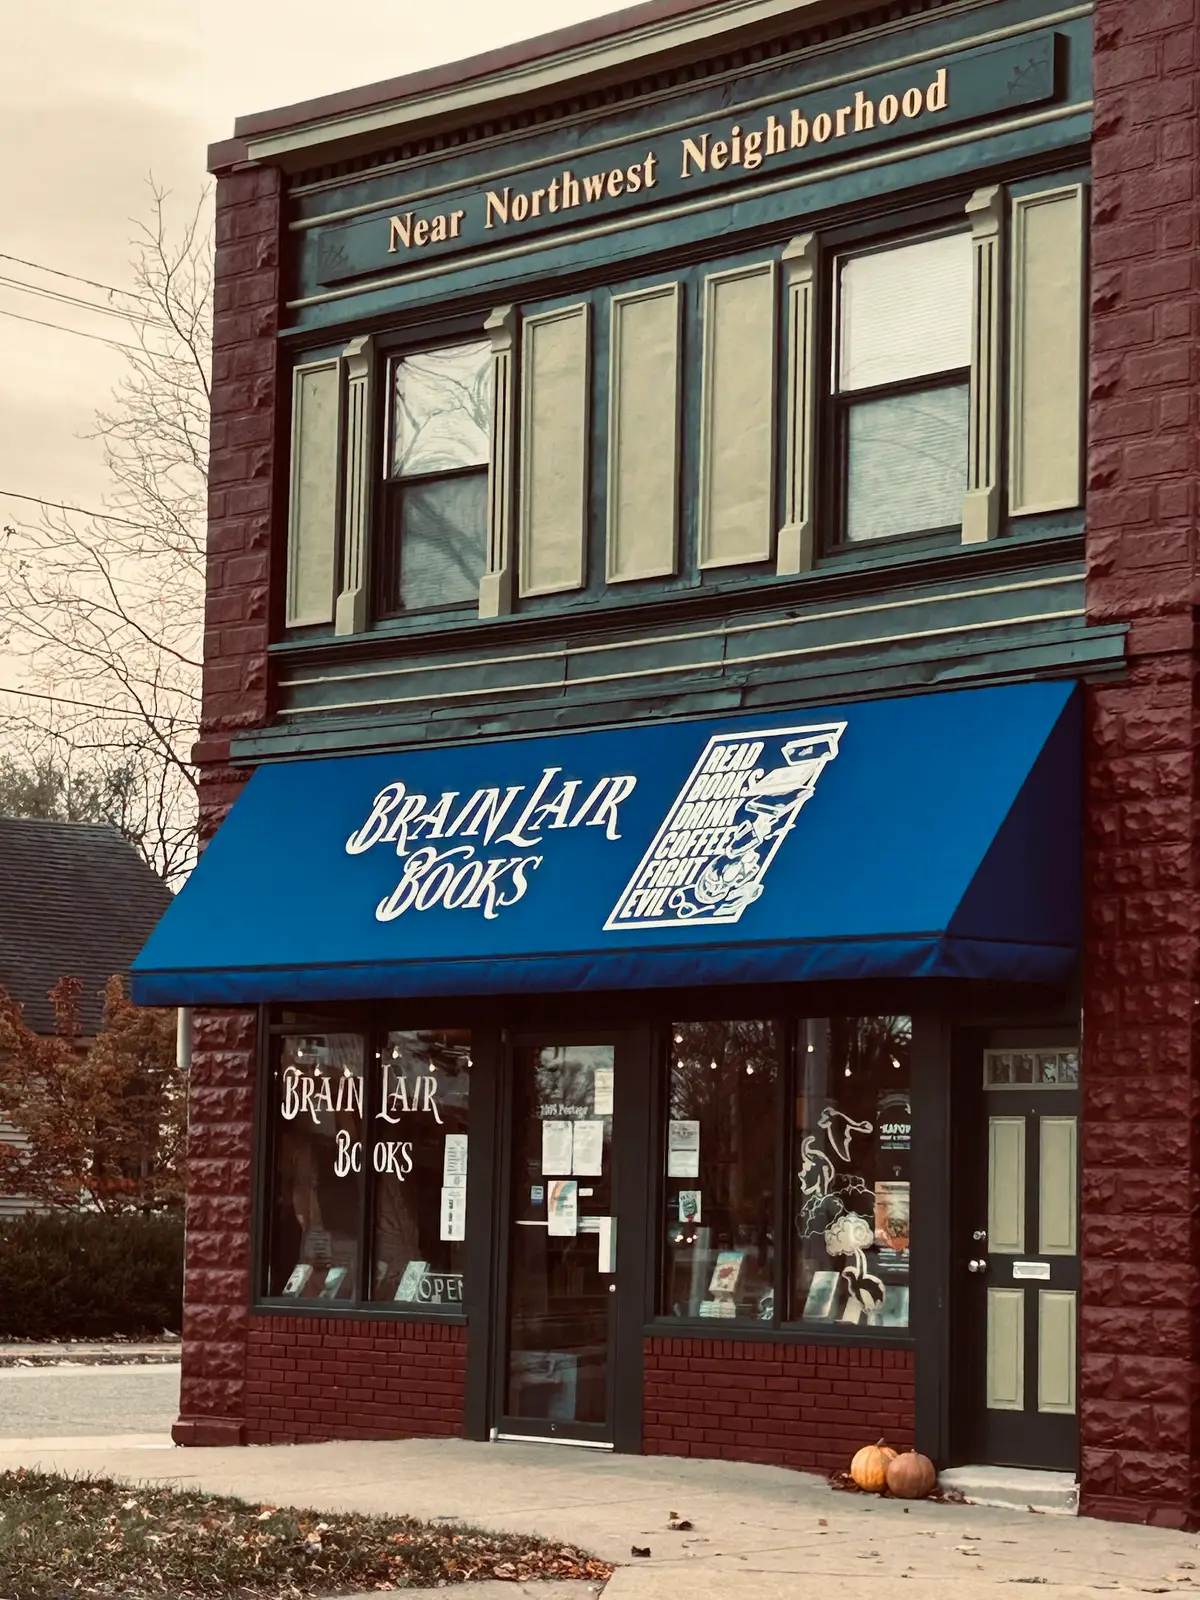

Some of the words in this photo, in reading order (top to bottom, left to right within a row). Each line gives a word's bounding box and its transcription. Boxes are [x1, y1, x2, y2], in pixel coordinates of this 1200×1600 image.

[388, 207, 465, 253] Near
[485, 151, 656, 229] Northwest
[680, 68, 948, 178] Neighborhood
[701, 742, 765, 774] READ
[686, 768, 765, 803] BOOKS
[345, 782, 525, 857] BRAIN
[494, 766, 637, 847] LAIR
[669, 798, 746, 831] DRINK
[654, 825, 739, 860] COFFEE
[375, 845, 543, 922] BOOKS
[636, 856, 708, 889] FIGHT
[619, 887, 671, 918] EVIL
[281, 1065, 364, 1125] BRAIN
[375, 1064, 444, 1124] LAIR
